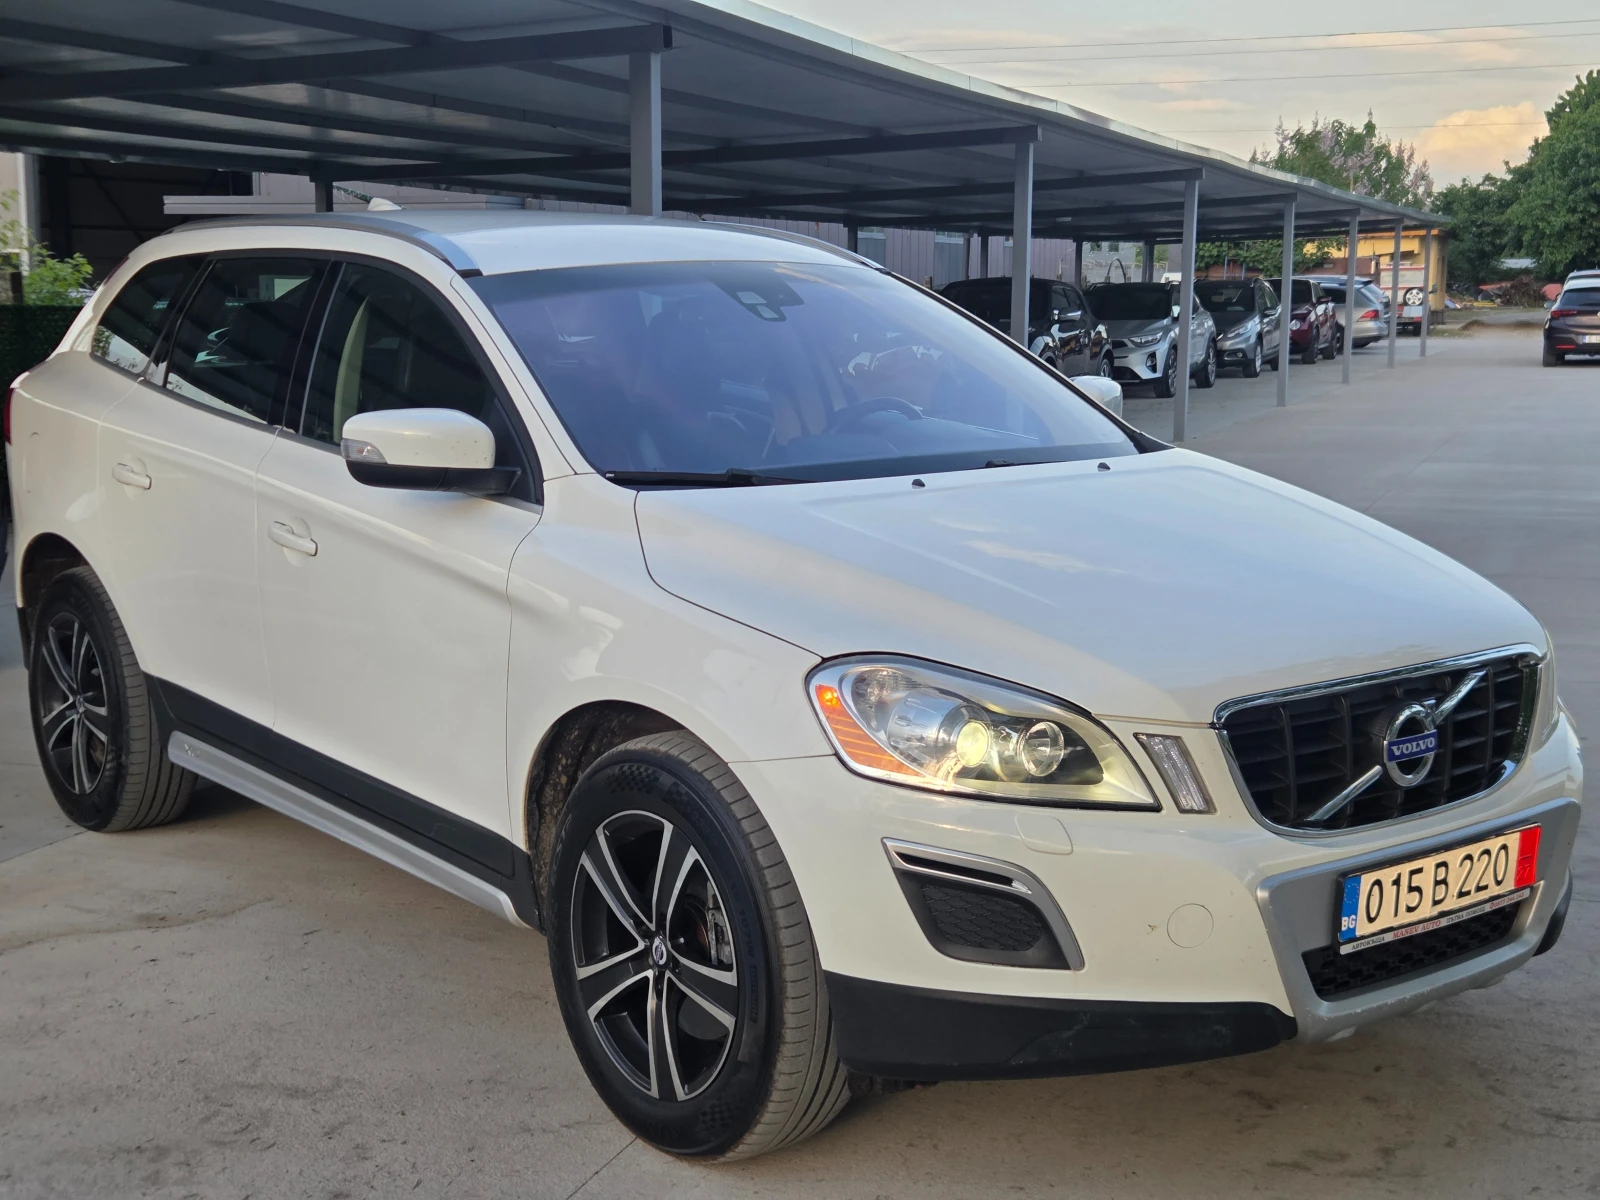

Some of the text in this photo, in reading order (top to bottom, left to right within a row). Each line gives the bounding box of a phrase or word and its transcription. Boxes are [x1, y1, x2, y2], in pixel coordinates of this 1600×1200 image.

[1391, 737, 1435, 756] VOLVO
[1341, 914, 1357, 931] BG
[1420, 920, 1442, 932] AUTO
